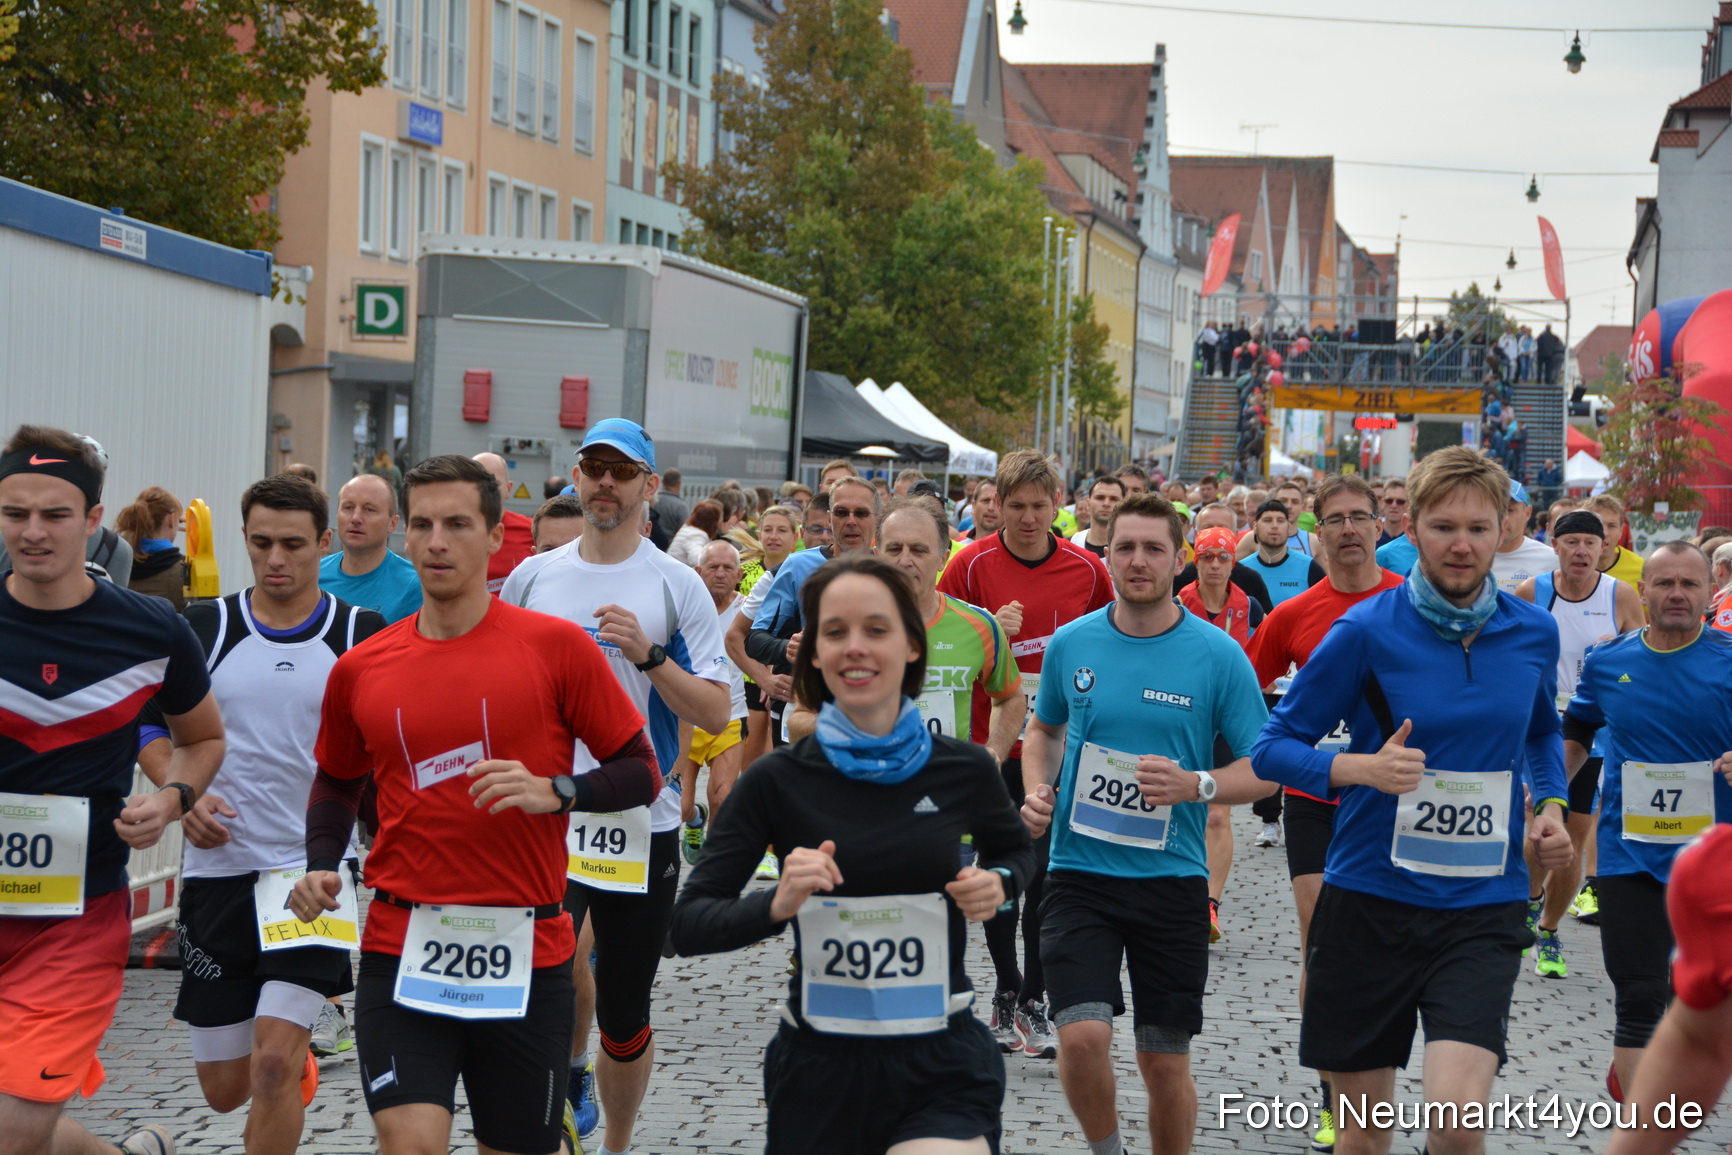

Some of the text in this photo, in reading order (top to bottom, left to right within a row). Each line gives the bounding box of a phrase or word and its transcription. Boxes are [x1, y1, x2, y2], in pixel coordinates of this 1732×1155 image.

[364, 291, 400, 329] D
[664, 349, 739, 389] OFFICE INDUSTRY LOUNGE
[751, 349, 791, 418] BOCK
[1353, 391, 1399, 410] ZIEL
[1023, 641, 1042, 652] DEHN
[1143, 689, 1192, 707] BOCK
[434, 754, 465, 775] DEHN
[1654, 771, 1686, 779] BOCK
[1447, 782, 1483, 791] BOCK
[1650, 788, 1683, 812] 47
[3, 805, 48, 818] BOCK
[1413, 800, 1494, 836] 2928
[1653, 821, 1682, 830] Albert
[574, 824, 627, 855] 149
[0, 831, 53, 868] 80
[581, 861, 617, 875] Markus
[0, 881, 42, 894] ichael
[452, 917, 497, 929] BOCK
[853, 909, 902, 922] BOCK
[263, 919, 333, 942] FELIX
[420, 939, 512, 980] 2269
[822, 936, 924, 981] 2929
[438, 987, 485, 1003] Jürgen
